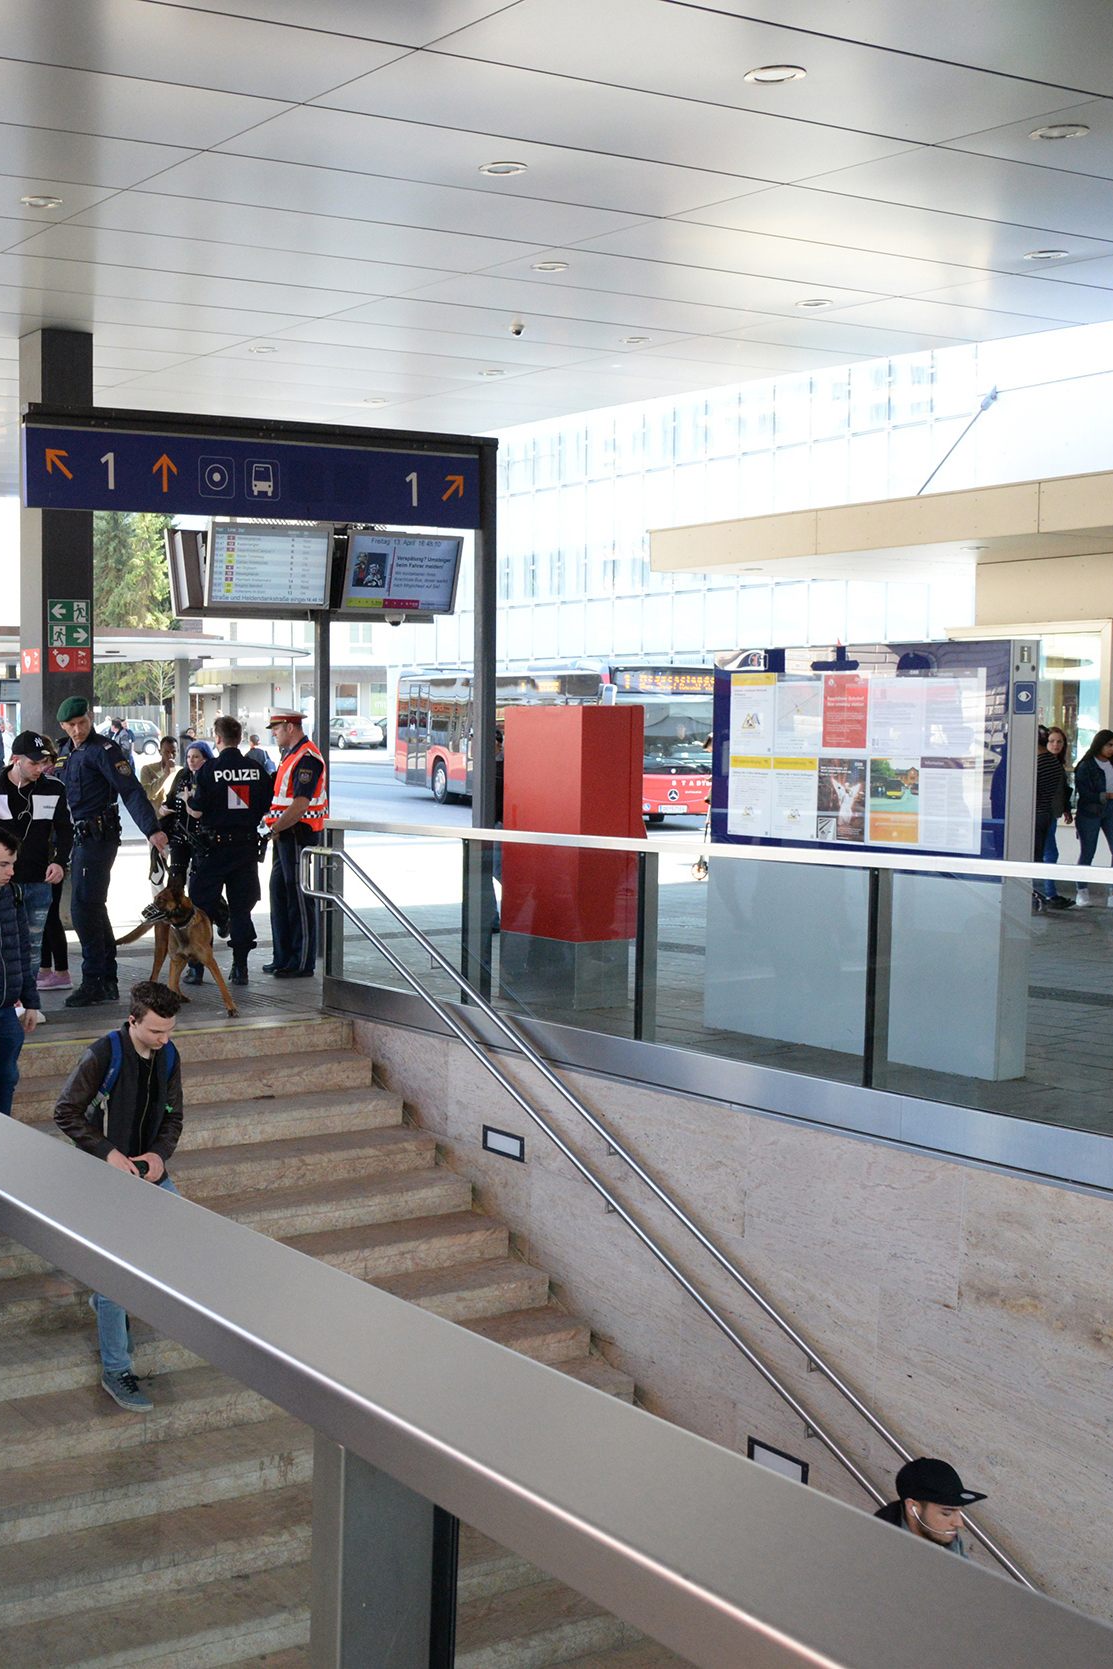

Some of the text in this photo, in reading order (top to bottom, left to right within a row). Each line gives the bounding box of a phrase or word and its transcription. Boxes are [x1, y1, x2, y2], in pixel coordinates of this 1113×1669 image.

[99, 452, 115, 490] 1
[405, 472, 419, 507] 1
[213, 768, 260, 783] POLIZEI
